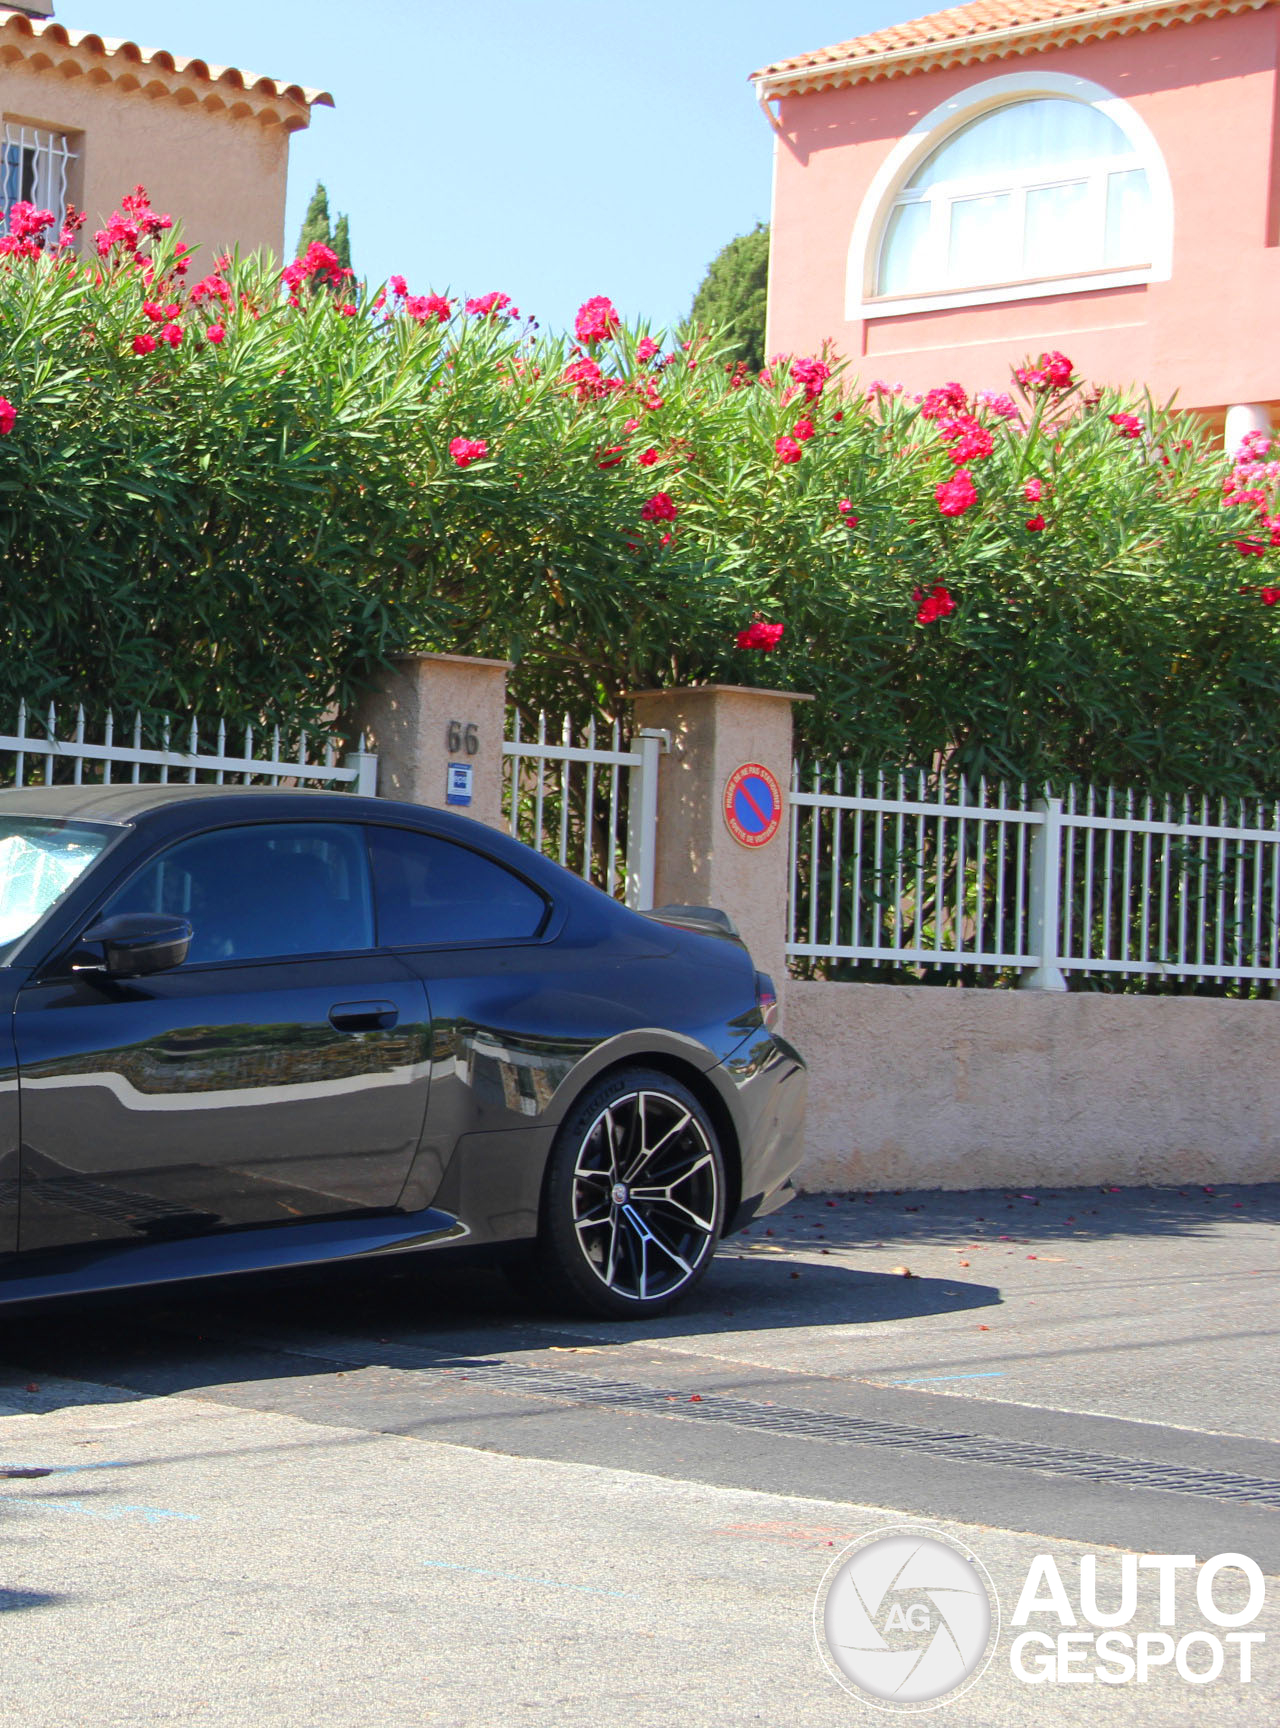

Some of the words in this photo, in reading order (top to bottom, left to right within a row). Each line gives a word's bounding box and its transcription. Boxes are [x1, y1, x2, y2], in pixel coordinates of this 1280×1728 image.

[447, 720, 480, 755] 66
[733, 773, 741, 783] DE
[749, 766, 760, 775] PAS
[760, 770, 780, 809] STATIONNER
[730, 818, 746, 840] SORTIE
[746, 835, 754, 843] DE
[754, 820, 776, 843] VOITURES
